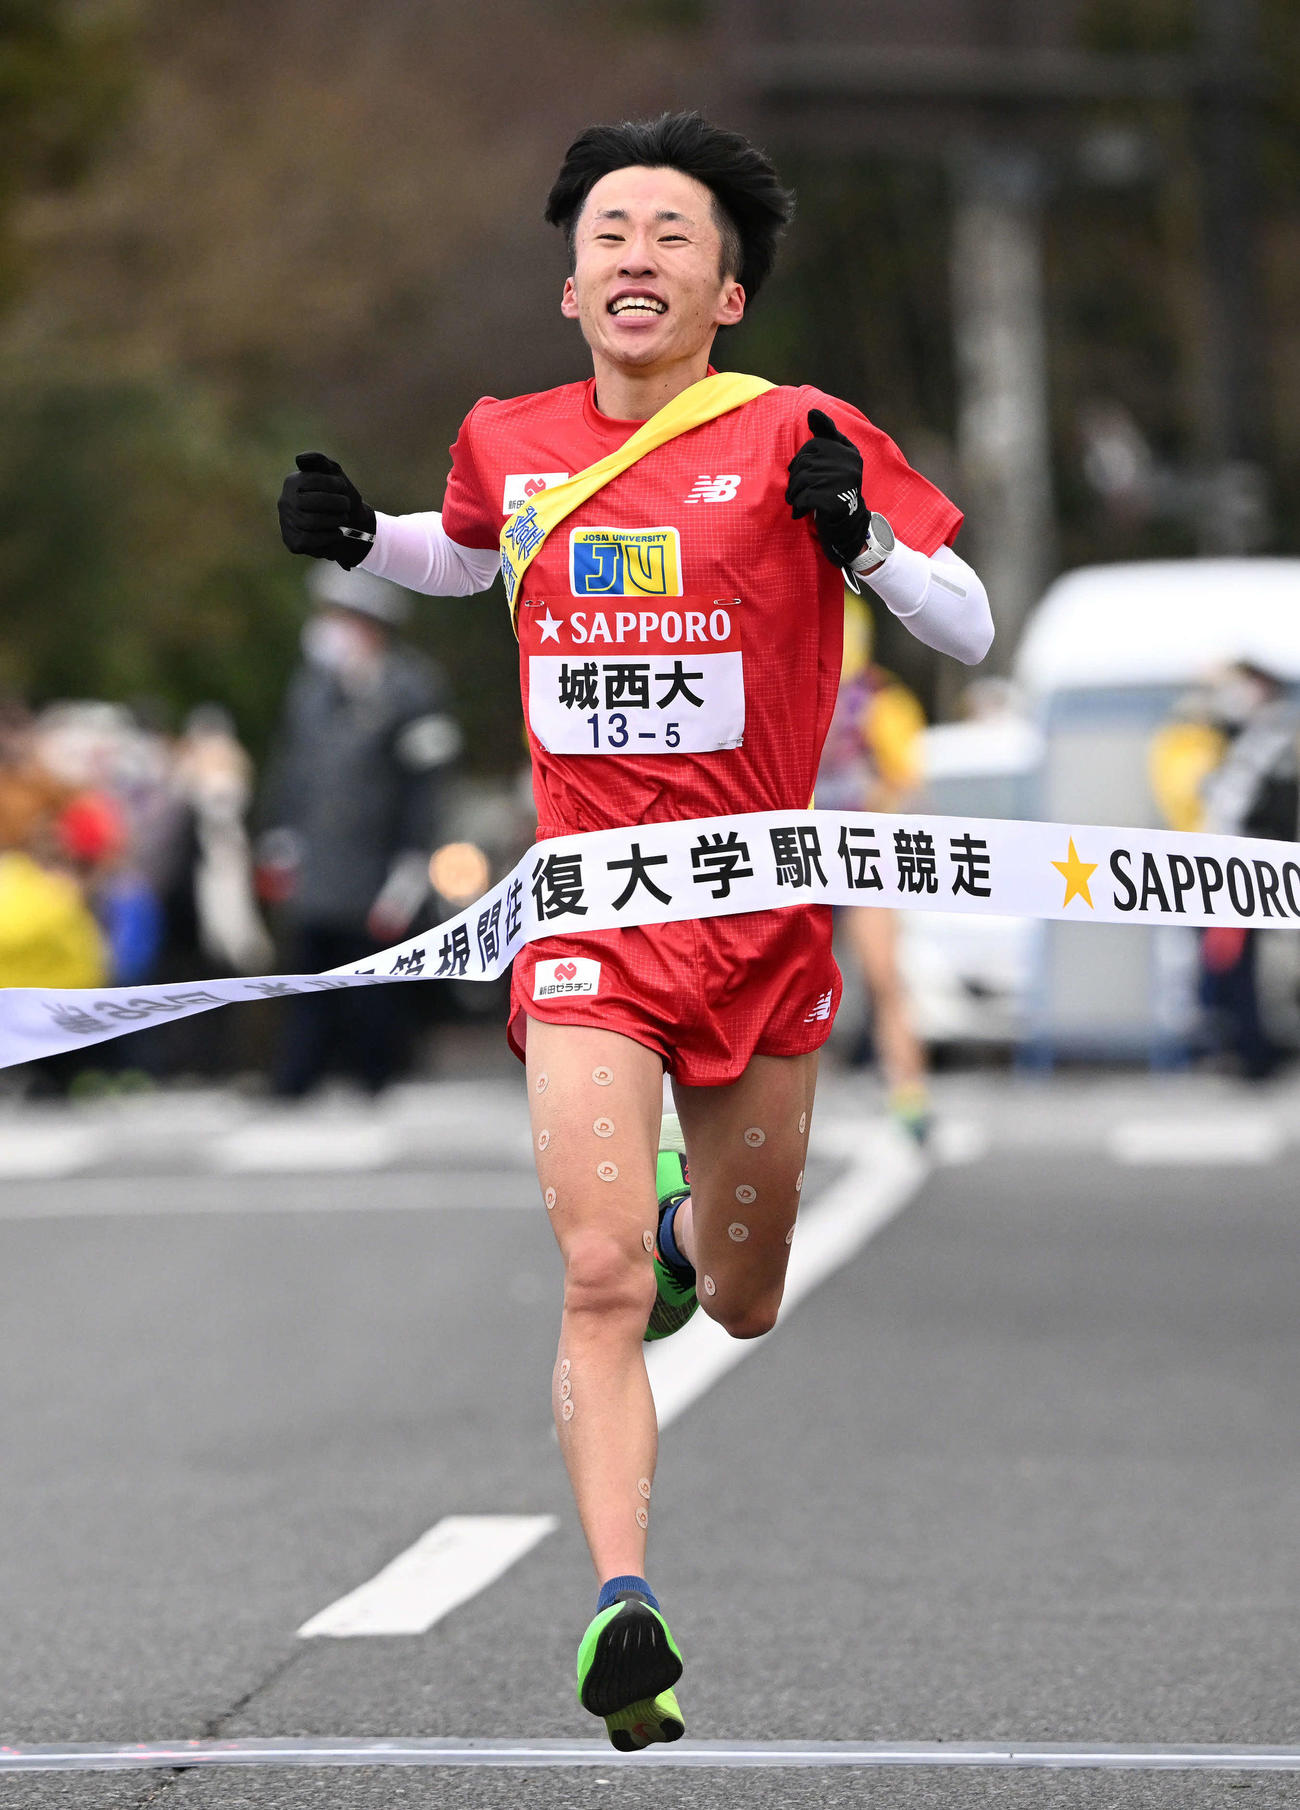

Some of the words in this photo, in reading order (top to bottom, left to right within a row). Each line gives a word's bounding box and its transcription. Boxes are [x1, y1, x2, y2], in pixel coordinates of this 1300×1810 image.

[583, 534, 609, 542] JOSAI
[612, 534, 667, 542] UNIVERSITY
[585, 544, 666, 594] JU
[570, 609, 731, 644] SAPPORO
[558, 660, 704, 710] 城西大
[539, 982, 592, 995] 新田ゼラチン
